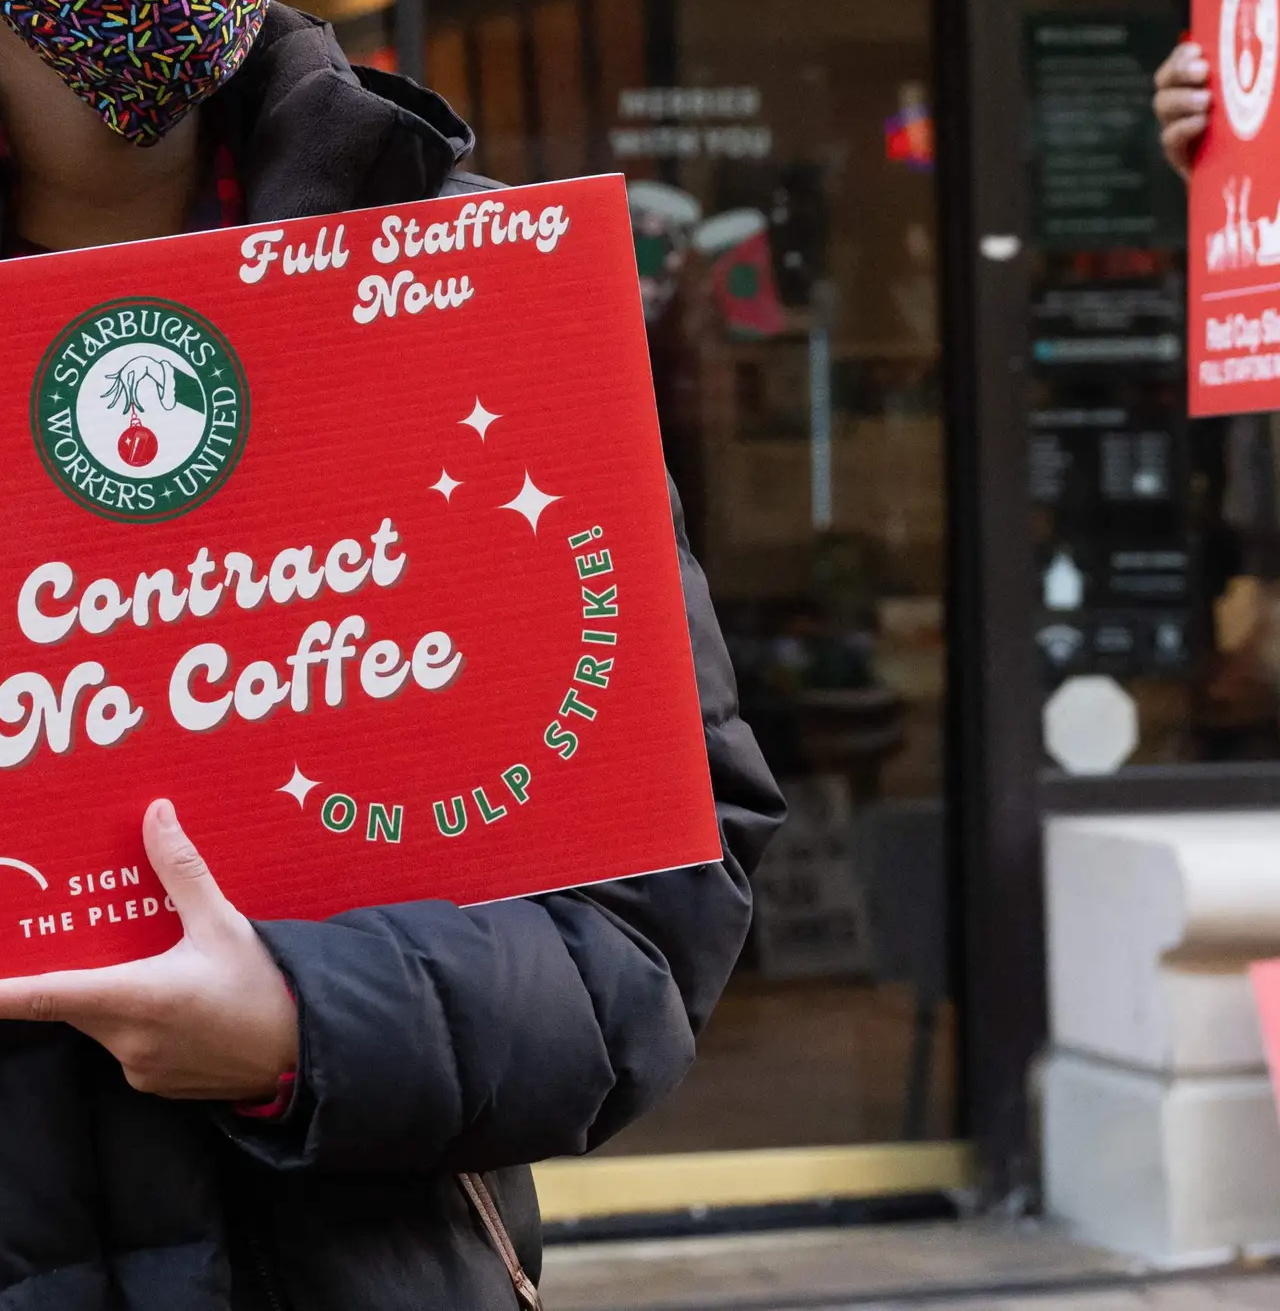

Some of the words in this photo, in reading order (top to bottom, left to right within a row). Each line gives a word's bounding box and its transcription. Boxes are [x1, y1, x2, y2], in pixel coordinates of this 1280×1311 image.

[238, 224, 351, 285] Full
[371, 199, 571, 261] Staffing
[352, 270, 476, 325] Now
[54, 309, 217, 387] STARBUCKS
[47, 407, 157, 510] WORKERS
[172, 386, 237, 497] UNITED
[17, 517, 408, 645] Contract
[168, 614, 464, 732] Coffee
[321, 793, 403, 843] ON
[433, 763, 532, 837] ULP
[543, 525, 618, 760] STRIKE!
[68, 865, 140, 896] SIGN
[19, 912, 74, 938] THE
